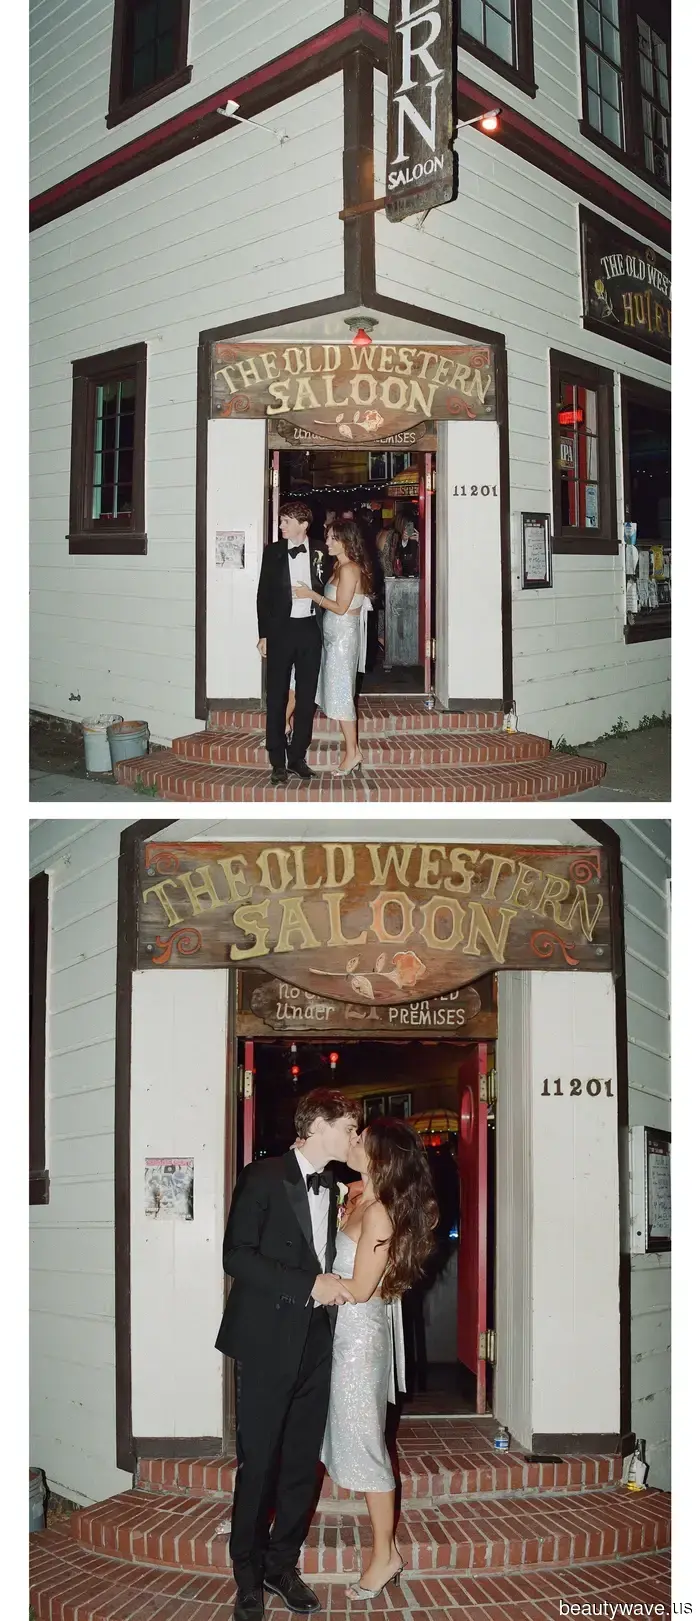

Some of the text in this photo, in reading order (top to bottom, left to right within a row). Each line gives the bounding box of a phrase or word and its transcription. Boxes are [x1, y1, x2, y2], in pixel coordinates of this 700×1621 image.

[390, 0, 445, 165] RN
[388, 154, 444, 190] SALOON
[600, 253, 625, 280] THE
[625, 254, 646, 281] OLD
[214, 344, 492, 404] THE OLD WESTERN
[266, 373, 439, 418] SALOON
[560, 443, 573, 462] IPA
[453, 485, 498, 497] 11201
[143, 843, 603, 943] THE OLD WESTERN
[229, 891, 518, 964] SALOON
[276, 1001, 335, 1020] Under
[388, 1007, 466, 1025] PREMISES
[541, 1077, 614, 1097] 11201
